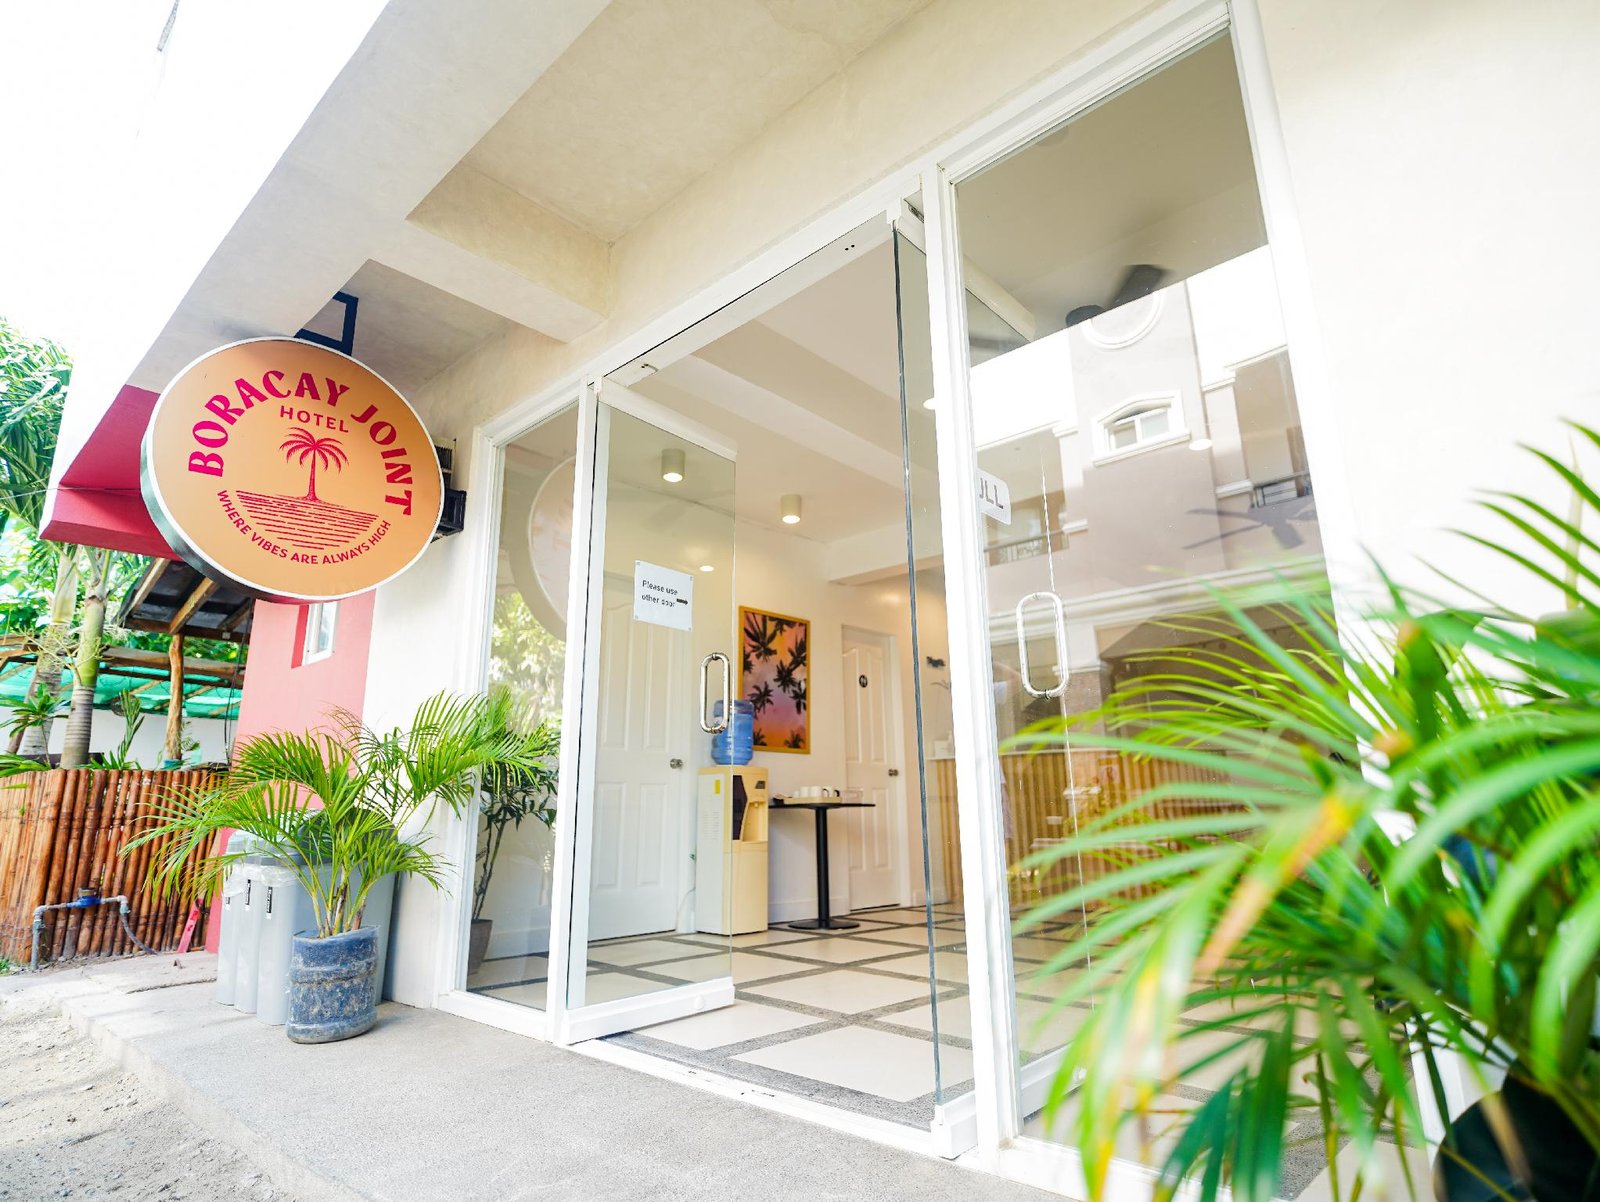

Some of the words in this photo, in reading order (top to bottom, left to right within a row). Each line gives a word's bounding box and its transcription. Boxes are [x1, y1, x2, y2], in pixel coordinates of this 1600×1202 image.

[280, 405, 349, 433] HOTEL
[188, 370, 350, 477] BORACAY
[350, 404, 413, 516] JOINT
[217, 490, 252, 535] WHERE
[251, 532, 288, 558] VIBES
[290, 552, 319, 565] ARE
[322, 541, 370, 564] ALWAYS
[368, 520, 391, 546] HIGH
[642, 580, 664, 592] Please
[642, 594, 659, 603] other
